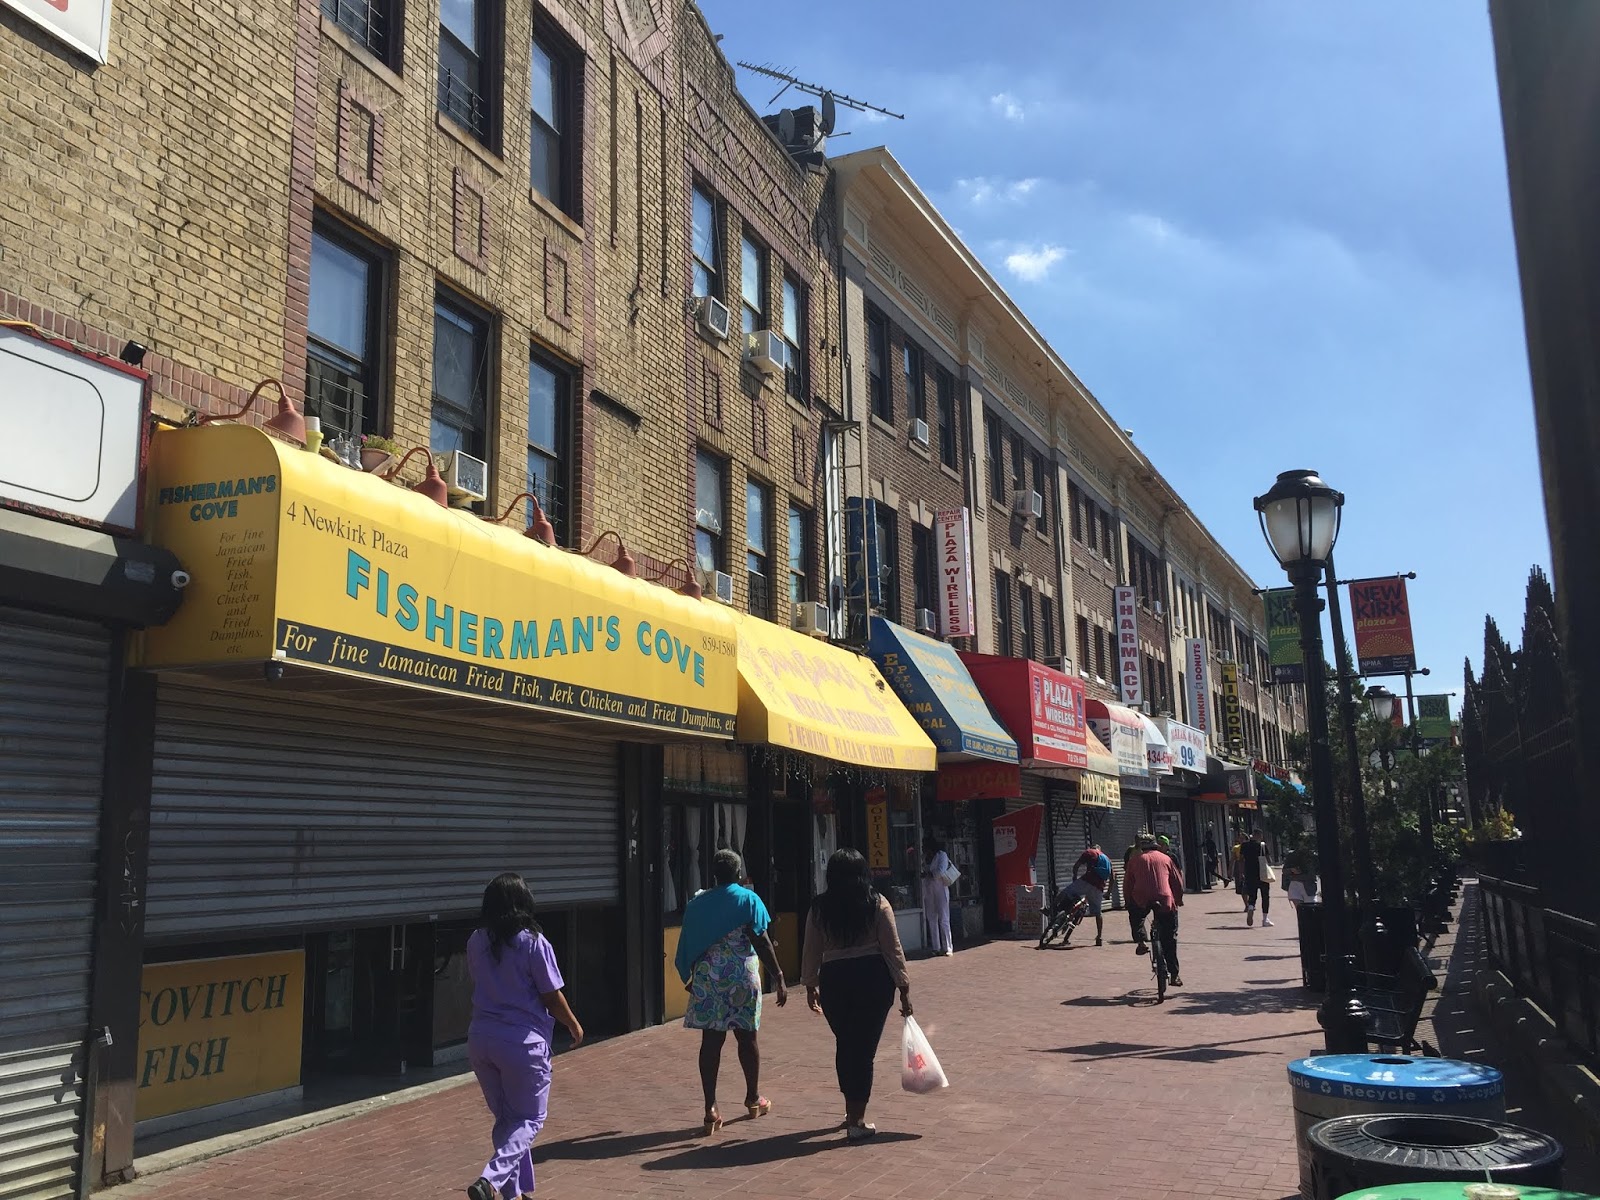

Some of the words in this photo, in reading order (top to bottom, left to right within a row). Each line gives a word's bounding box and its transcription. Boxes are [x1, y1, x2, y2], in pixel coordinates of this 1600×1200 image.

[160, 475, 276, 505] FISHERMAN'S
[190, 500, 238, 521] COVE
[937, 514, 962, 522] CENTER
[219, 532, 235, 543] For
[243, 529, 264, 542] fine
[286, 501, 297, 521] 4
[302, 505, 367, 546] Newkirk
[372, 529, 409, 559] Plaza
[216, 543, 266, 556] Jamaican
[945, 523, 958, 562] PLAZA
[226, 555, 254, 567] Fried
[228, 582, 249, 592] Jerk
[1354, 583, 1402, 600] NEW
[216, 593, 259, 605] Chicken
[944, 567, 961, 633] WIRELESS
[227, 605, 247, 616] and
[346, 548, 621, 659] FISHERMAN'S
[637, 621, 704, 688] COVE
[1356, 601, 1406, 619] KIRK
[223, 616, 251, 628] Fried
[1270, 625, 1297, 637] plaza
[1356, 618, 1386, 630] plaza
[702, 636, 736, 658] 859-1580
[1119, 591, 1138, 700] PHARMACY
[883, 653, 898, 666] E
[1193, 643, 1203, 680] DONUTS
[282, 624, 318, 653] For
[328, 636, 369, 664] fine
[379, 647, 458, 682] Jamaican
[465, 665, 505, 692] Fried
[512, 675, 543, 701] Fish,
[550, 683, 574, 705] Jerk
[580, 689, 623, 713] Chicken
[628, 701, 648, 717] and
[652, 703, 677, 722] Fried
[682, 708, 722, 731] Dumplins,
[1043, 678, 1074, 710] PLAZA
[1045, 706, 1075, 727] WIRELESS
[1197, 690, 1206, 730] DUNKIN'
[788, 722, 795, 744] 5
[795, 725, 831, 753] NEWKIRK
[834, 738, 859, 760] PLAZA
[870, 806, 884, 866] OPTICAL
[995, 827, 1015, 835] ATM
[138, 1036, 231, 1088] FISH
[1343, 1084, 1416, 1101] Recycle
